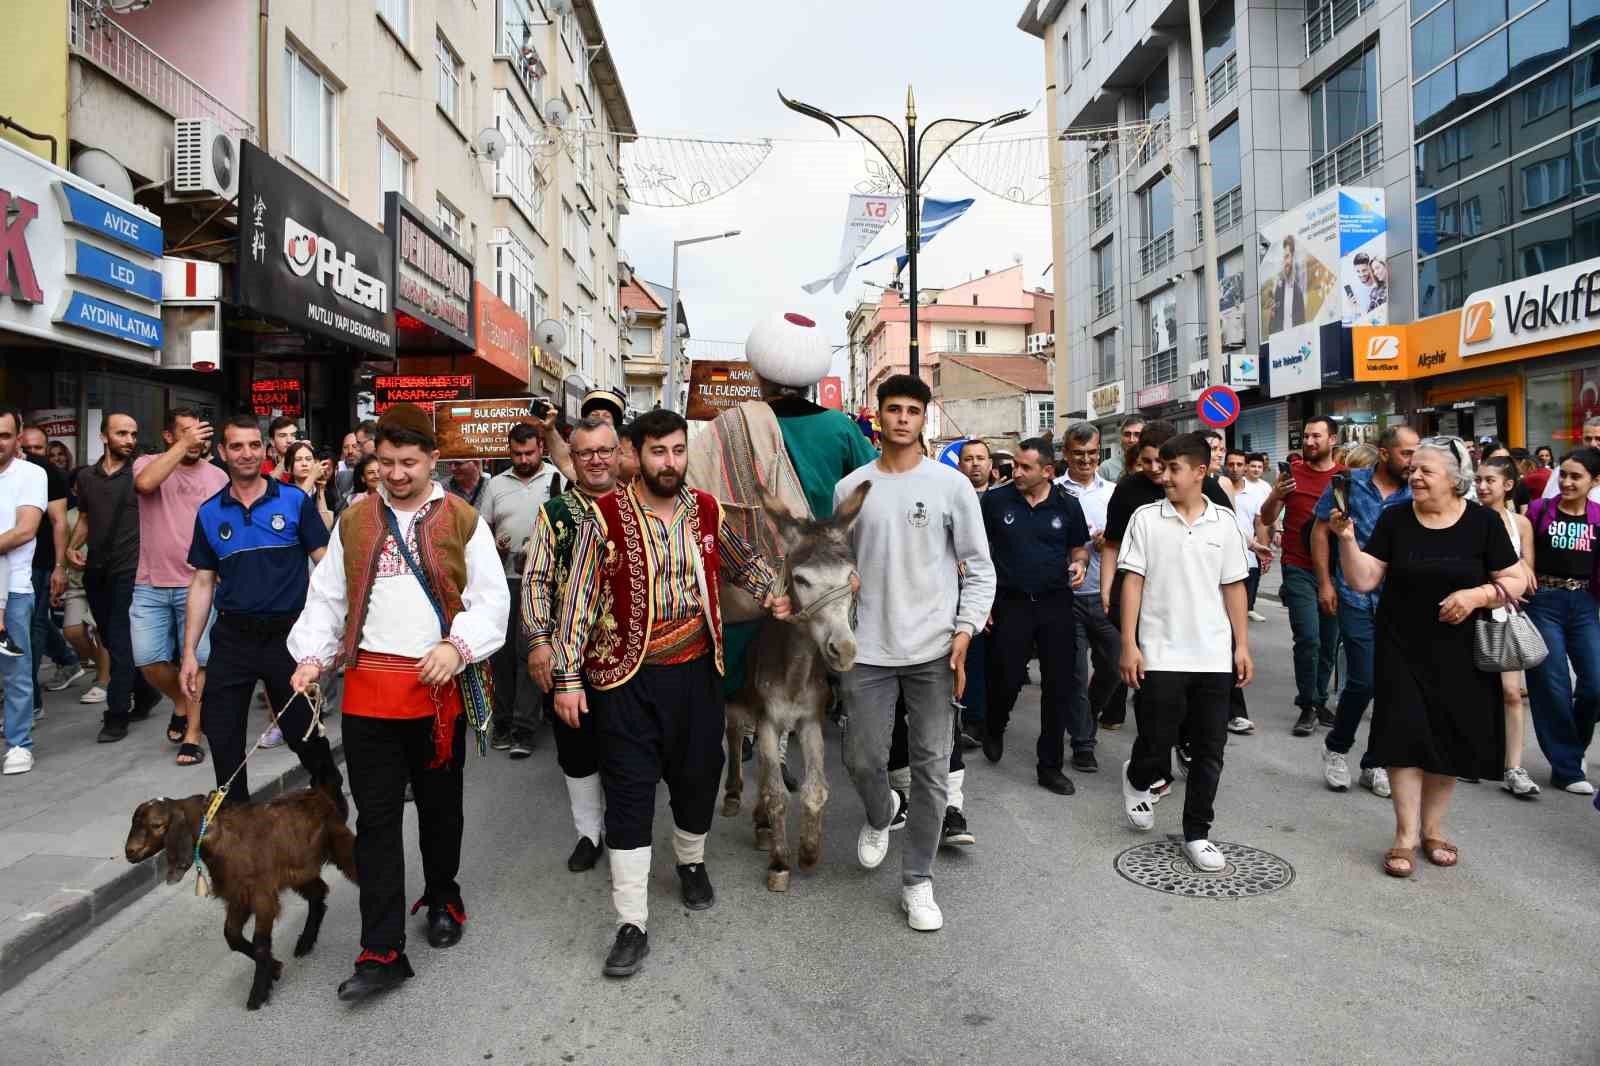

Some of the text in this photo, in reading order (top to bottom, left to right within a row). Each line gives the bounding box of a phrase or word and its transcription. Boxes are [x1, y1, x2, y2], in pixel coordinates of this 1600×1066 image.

[110, 262, 135, 285] LED
[80, 303, 159, 341] AYDINLATMA
[308, 303, 391, 347] MUTLU YAPI DEKORASYON
[491, 422, 521, 433] PETA
[1548, 520, 1597, 540] GO GIRL
[1551, 535, 1592, 552] GO GIRL
